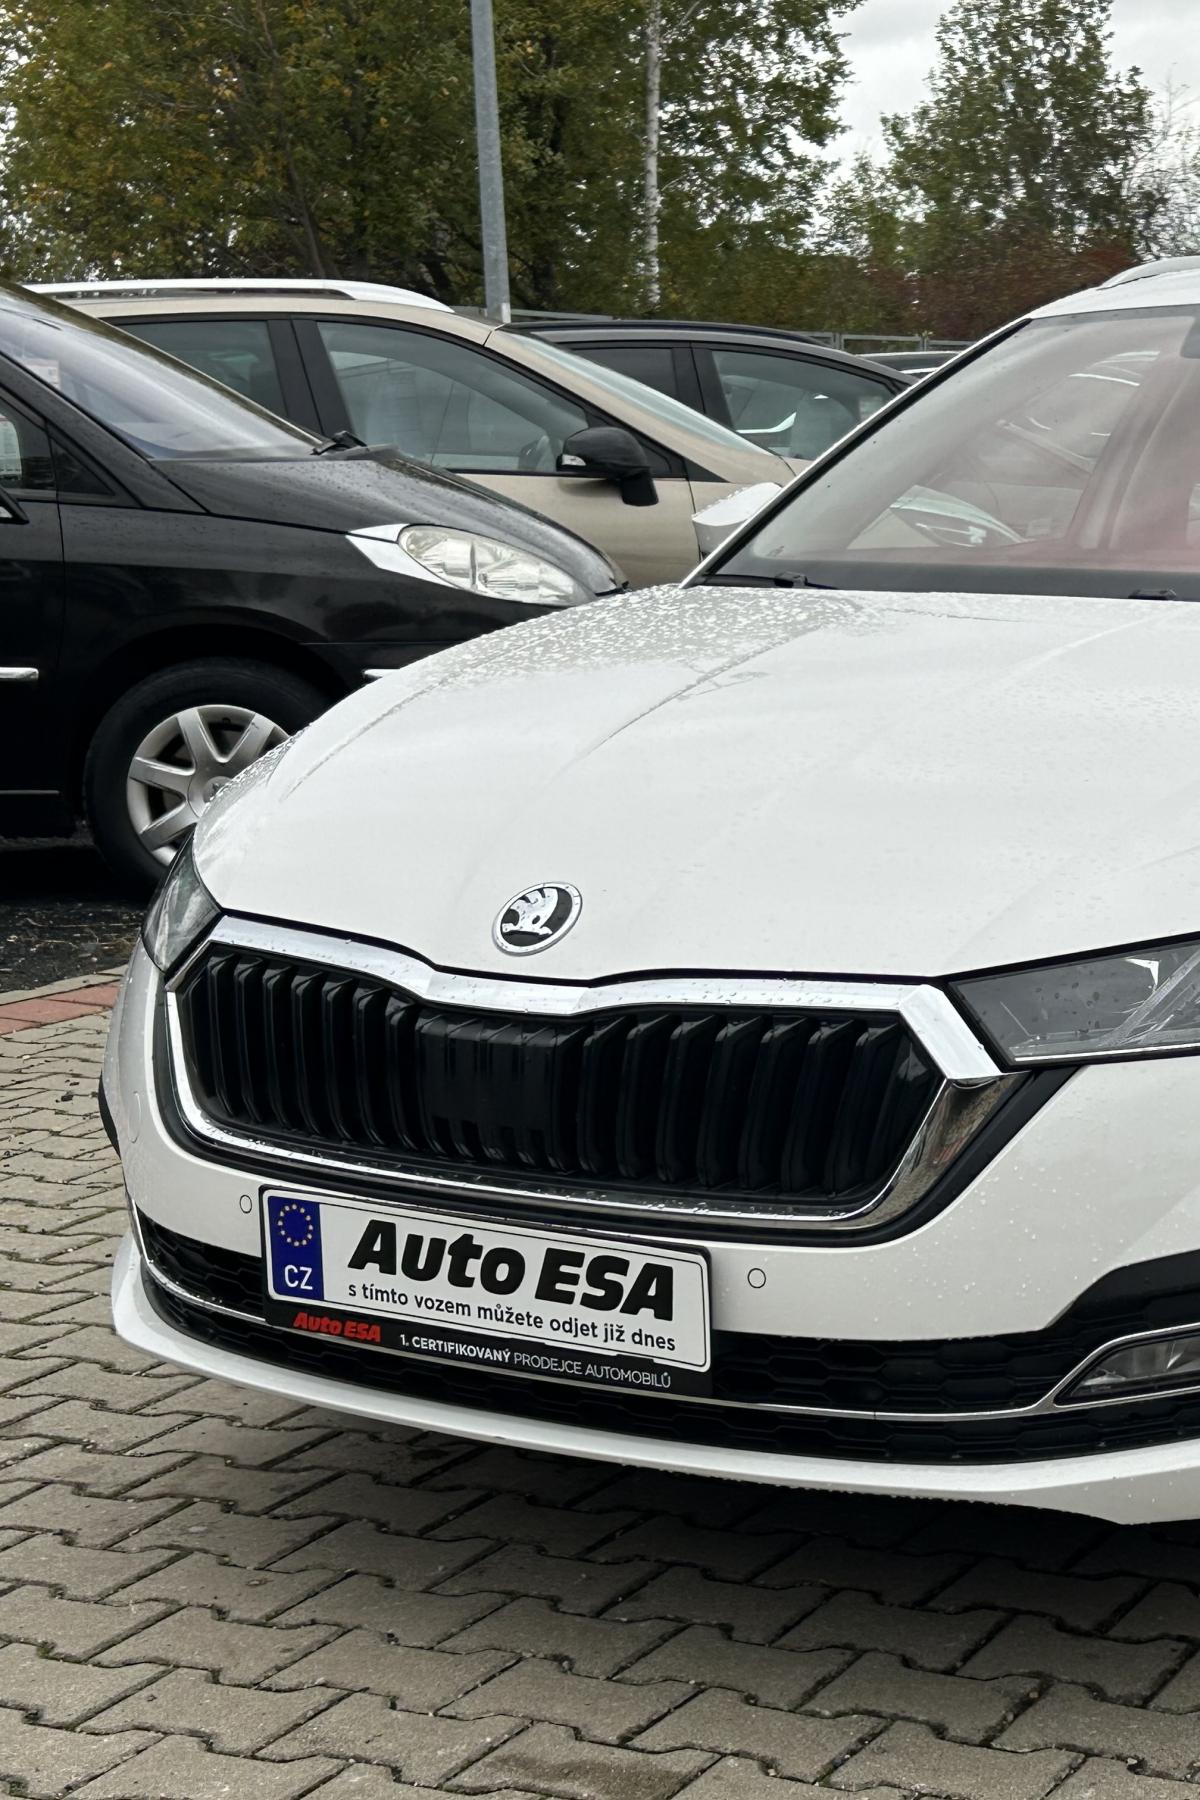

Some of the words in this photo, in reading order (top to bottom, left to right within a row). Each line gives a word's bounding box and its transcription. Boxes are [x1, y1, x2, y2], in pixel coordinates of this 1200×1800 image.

[284, 1264, 314, 1291] CZ
[347, 1219, 526, 1295] Auto
[534, 1247, 674, 1322] ESA
[293, 1311, 342, 1335] Auto
[343, 1320, 382, 1343] ESA
[348, 1284, 357, 1297] s
[362, 1283, 408, 1305] tímto
[414, 1294, 471, 1317] vozem
[477, 1303, 544, 1329] můžete
[549, 1317, 598, 1338] odjet
[603, 1323, 626, 1343] již
[631, 1328, 676, 1351] dnes
[400, 1334, 409, 1347] 1.
[412, 1336, 511, 1363] CERTIFIKOVANÝ
[513, 1352, 582, 1375] PRODEJCE
[584, 1364, 672, 1388] AUTOMOBILŮ
